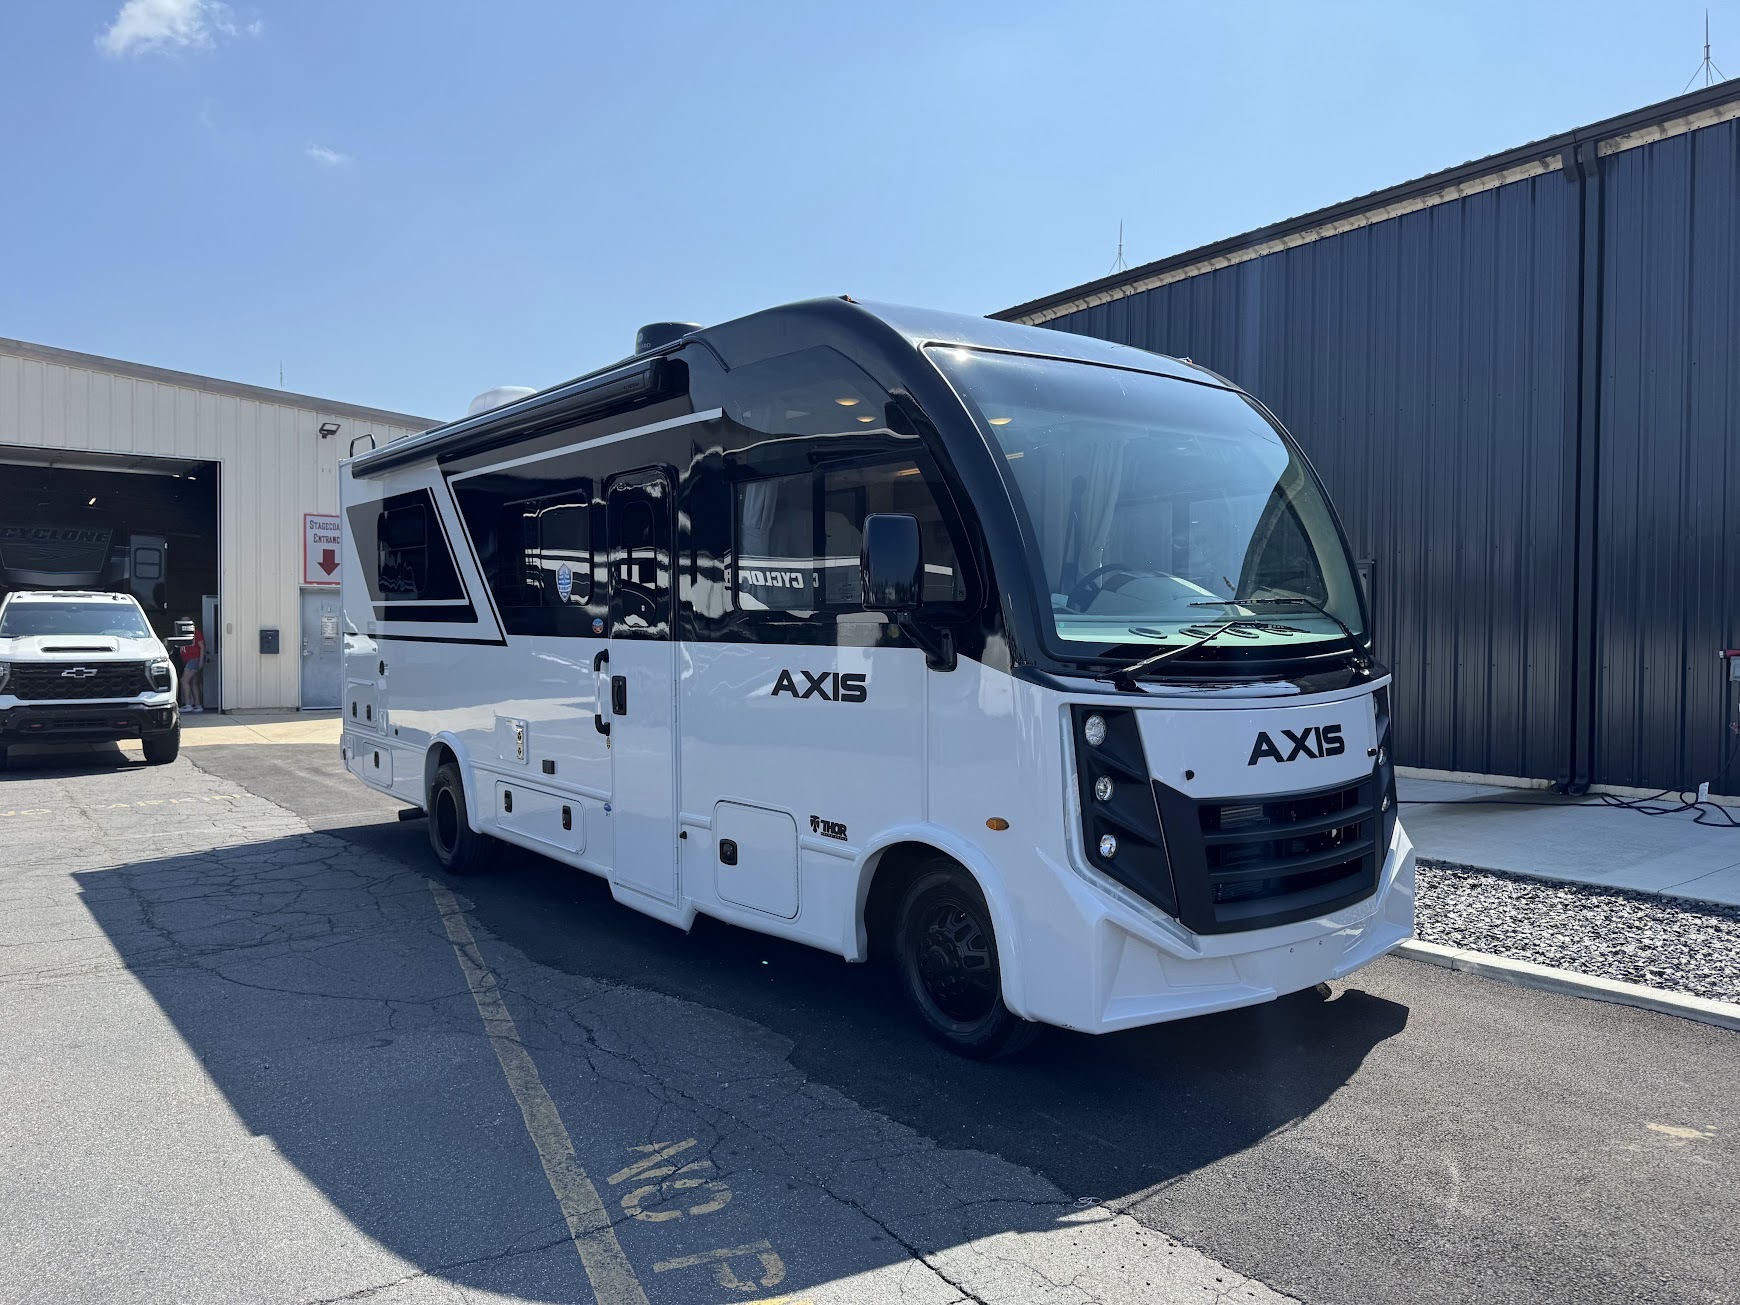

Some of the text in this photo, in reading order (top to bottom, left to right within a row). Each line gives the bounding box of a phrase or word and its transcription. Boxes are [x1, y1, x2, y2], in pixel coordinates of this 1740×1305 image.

[309, 519, 340, 531] STAGECOA
[0, 527, 112, 543] CYCLONE
[313, 533, 340, 545] ENTRANC
[771, 669, 867, 703] AXIS
[1248, 724, 1345, 766] AXIS
[820, 819, 848, 837] THOR
[606, 1137, 733, 1222] NO
